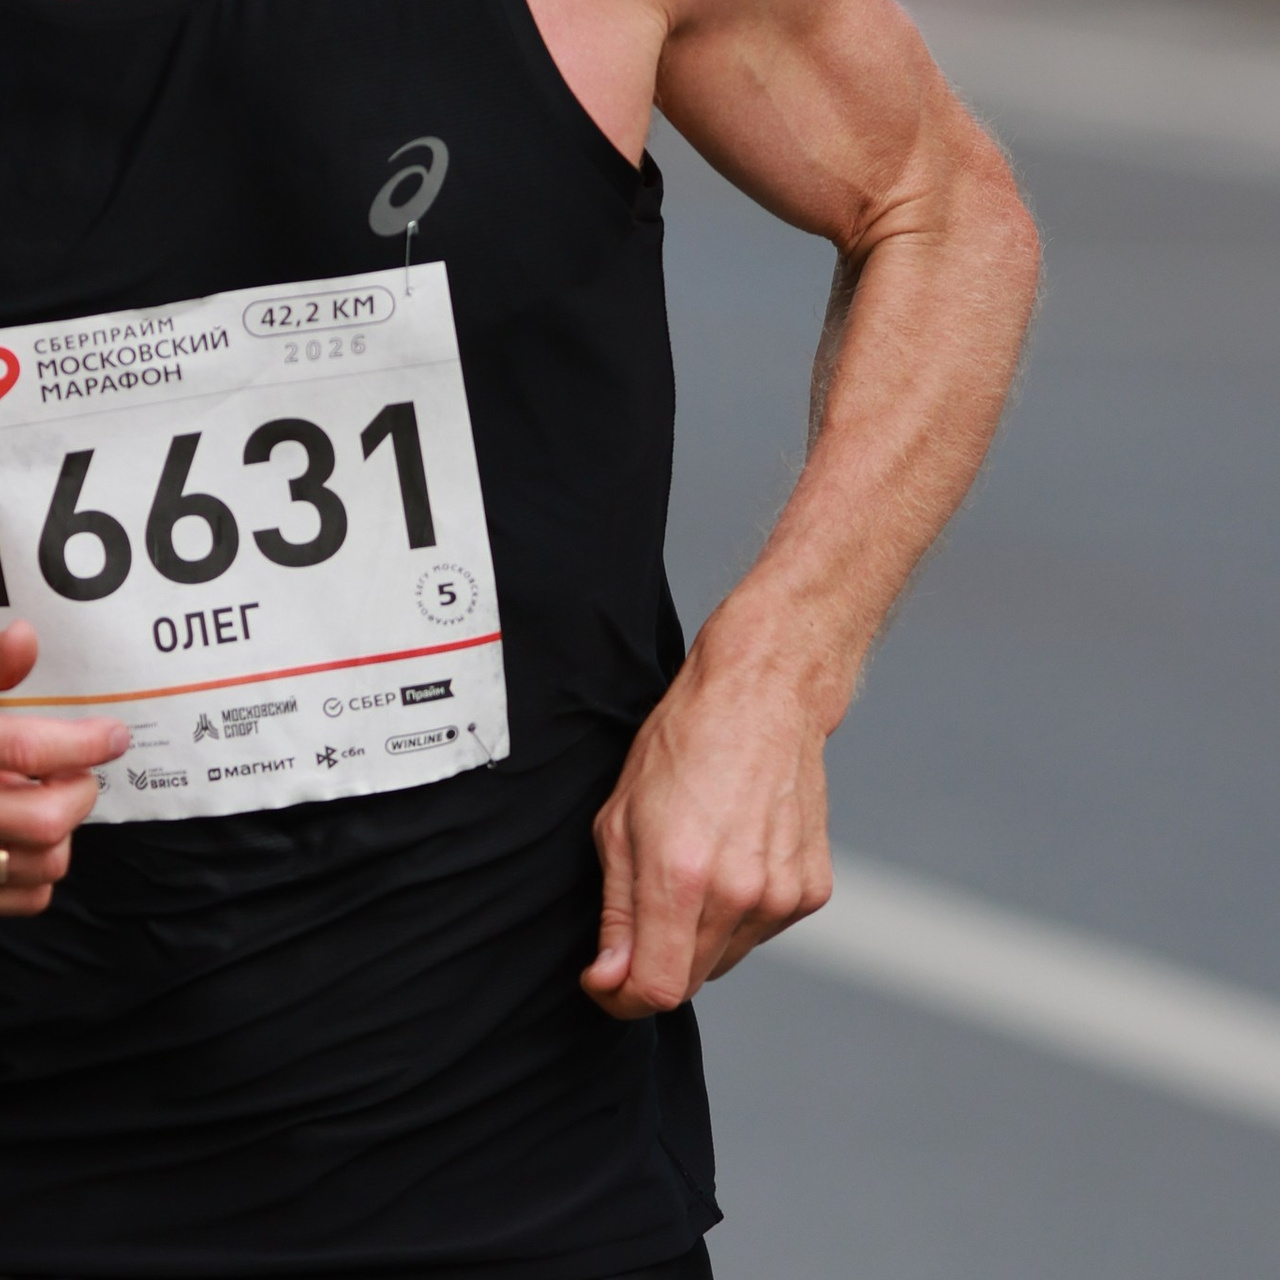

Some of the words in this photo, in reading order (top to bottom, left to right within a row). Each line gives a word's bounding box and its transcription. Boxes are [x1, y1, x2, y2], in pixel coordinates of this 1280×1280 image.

[261, 302, 319, 327] 42,2
[34, 317, 174, 354] СБЕРПРАЙМ
[283, 333, 367, 364] 2026
[37, 326, 230, 379] МОСКОВСКИЙ
[40, 363, 183, 403] МАРАФОН
[437, 582, 457, 607] 5
[152, 602, 261, 653] ОЛЕГ
[221, 695, 298, 724] МОСКОВСКИЙ
[348, 692, 396, 711] СБЕР
[405, 685, 446, 703] Прайм
[224, 720, 260, 739] СПОРТ
[391, 732, 444, 751] WINLINE
[150, 776, 188, 789] BRICS
